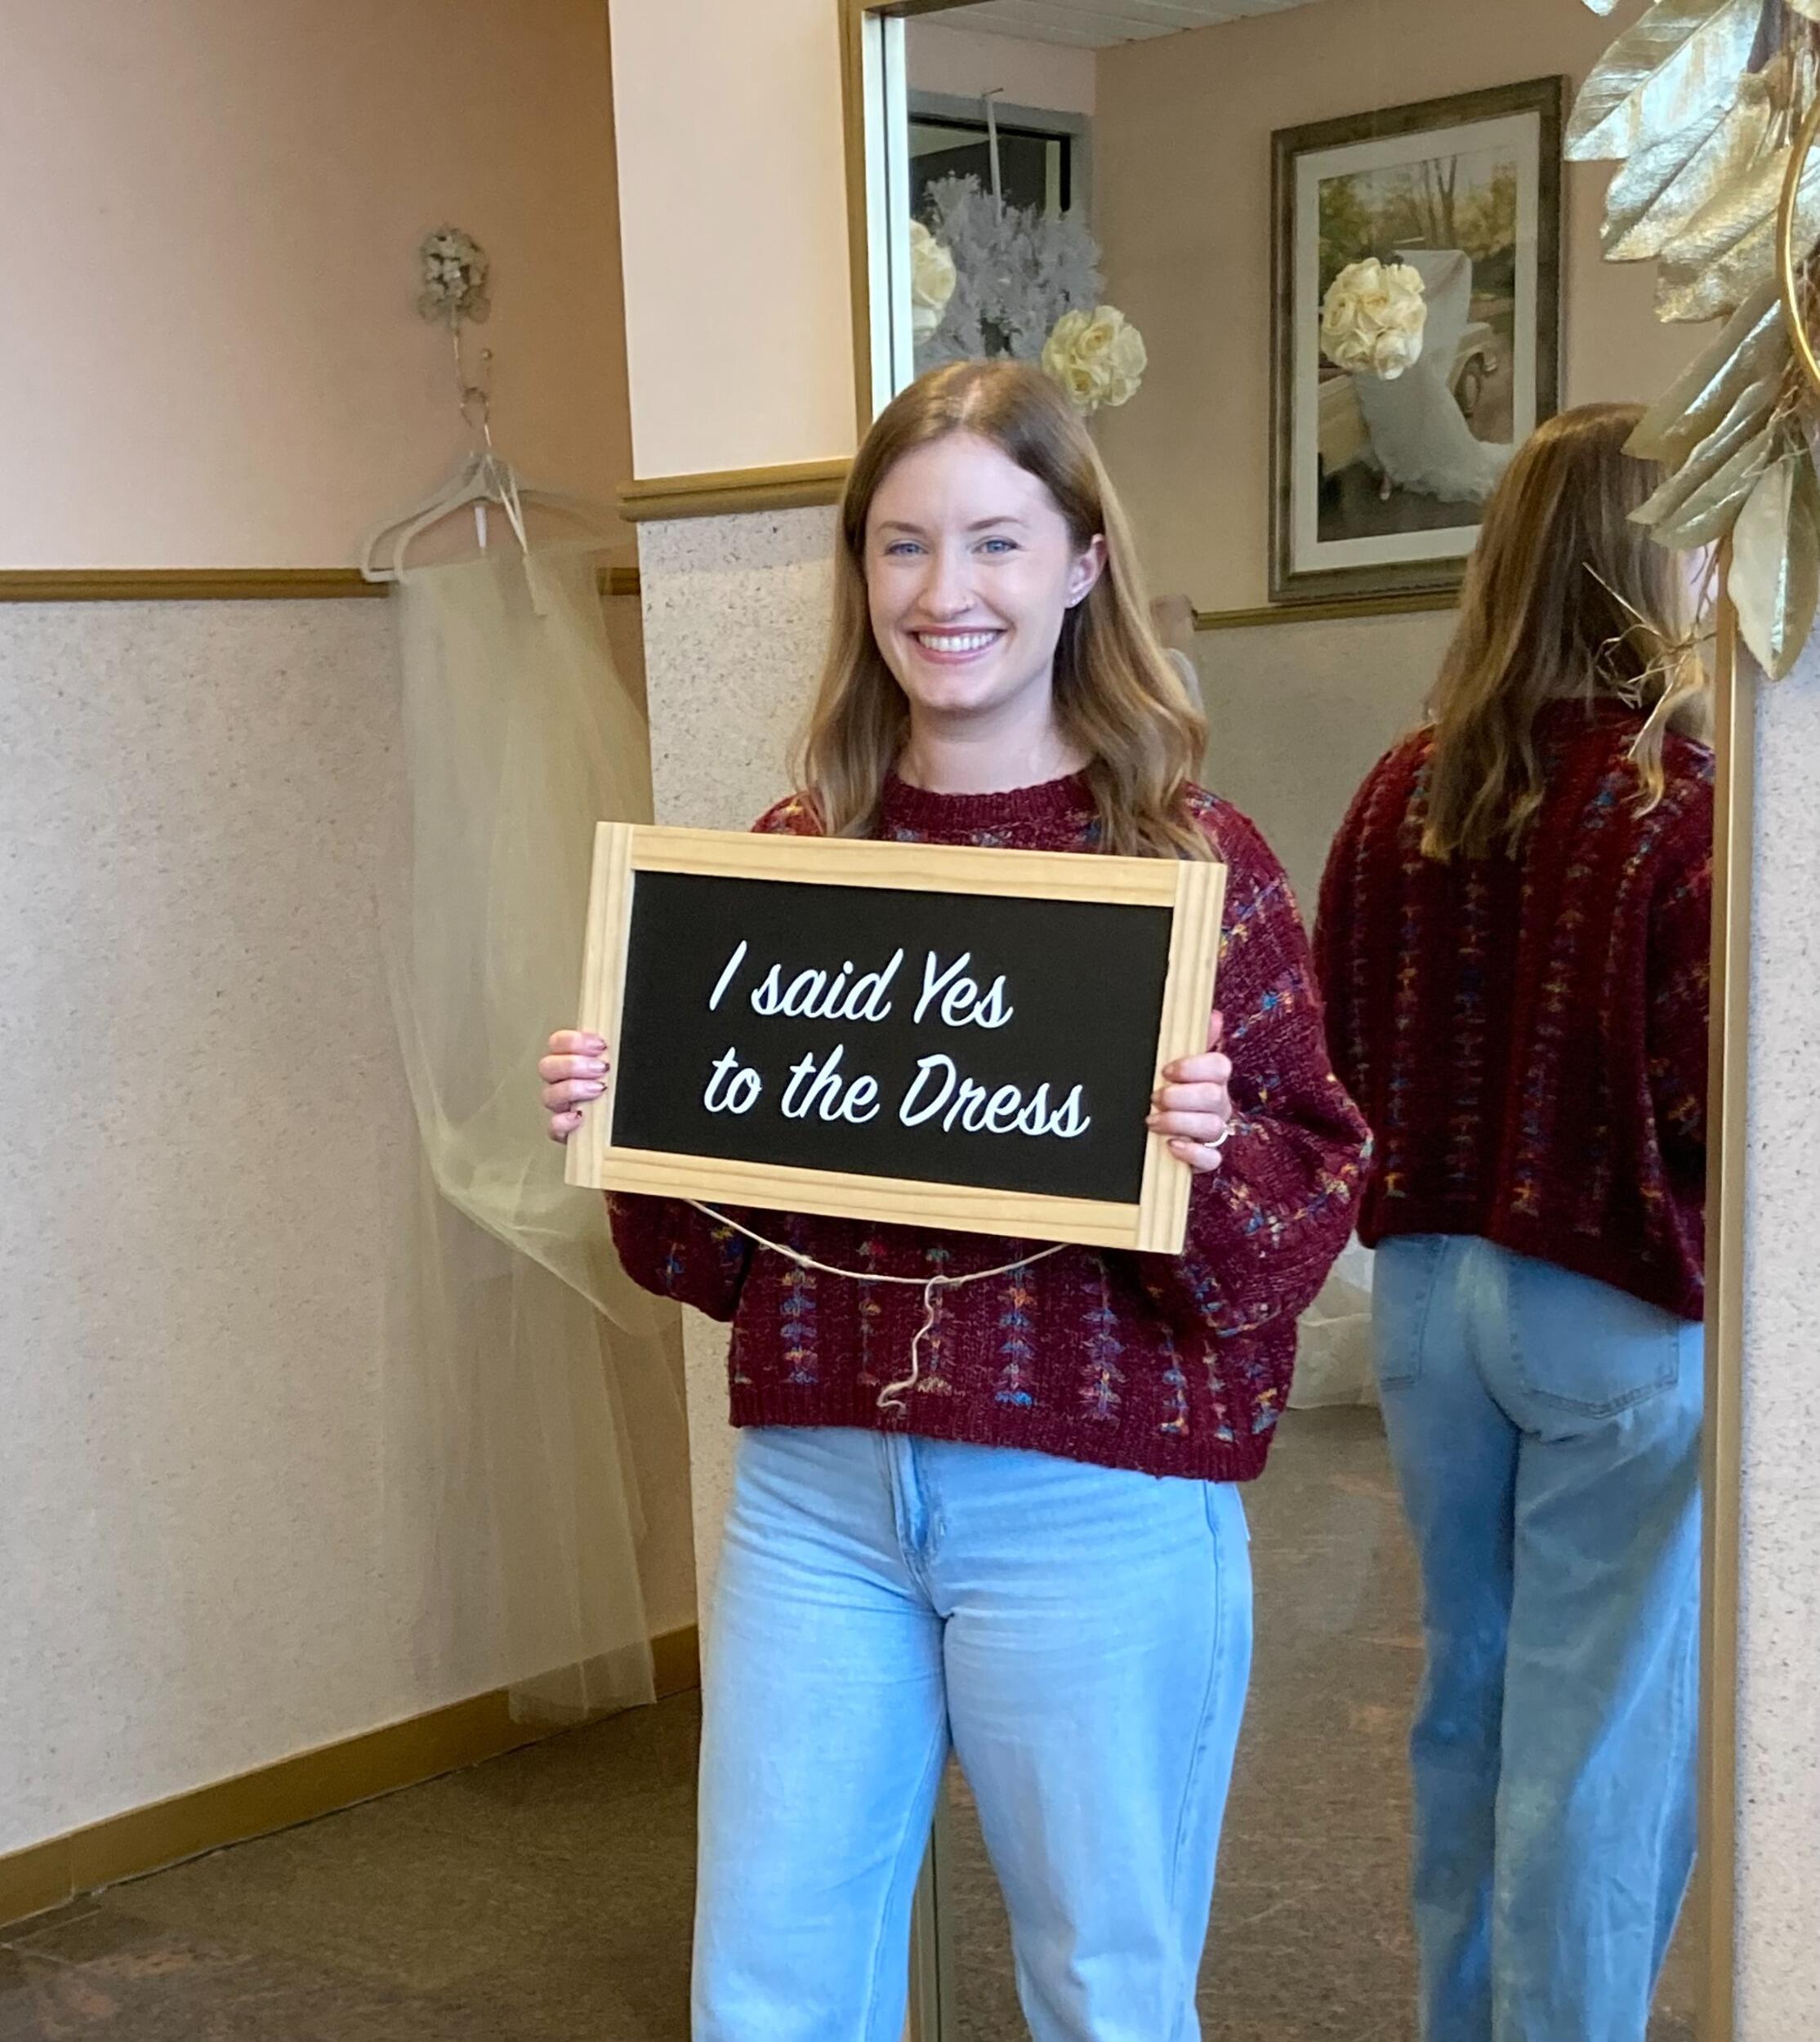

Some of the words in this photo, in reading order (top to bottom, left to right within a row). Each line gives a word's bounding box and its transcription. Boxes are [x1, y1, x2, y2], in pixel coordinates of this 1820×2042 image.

[709, 940, 747, 1011] I
[751, 947, 904, 1022] said
[913, 950, 1014, 1028] Yes
[703, 1046, 763, 1114] to
[781, 1043, 881, 1123] the
[899, 1054, 1091, 1138] Dress
